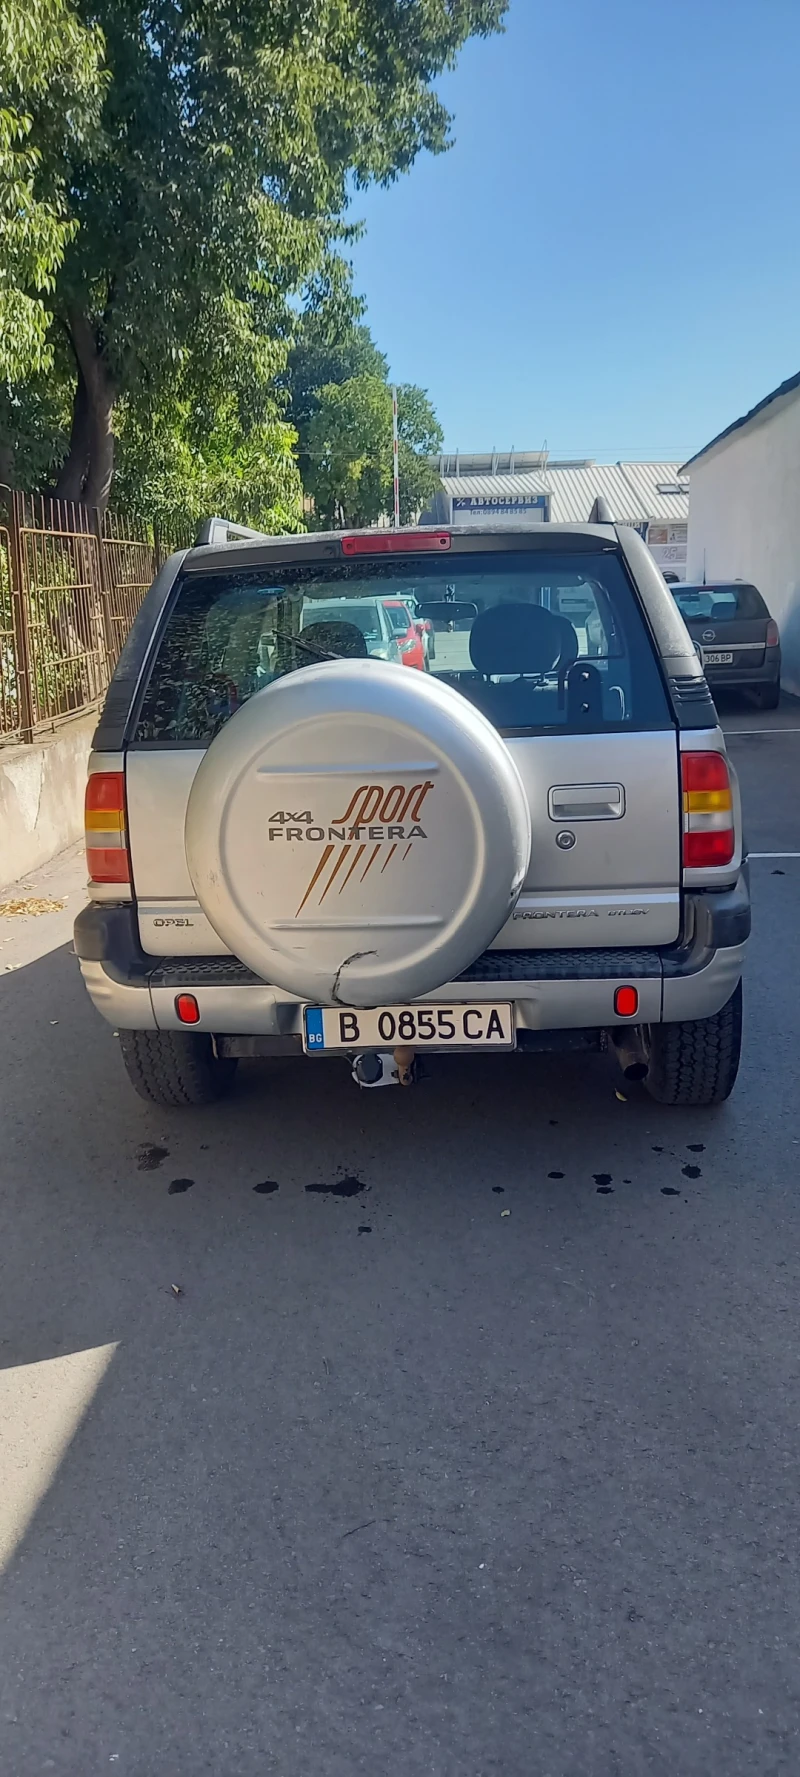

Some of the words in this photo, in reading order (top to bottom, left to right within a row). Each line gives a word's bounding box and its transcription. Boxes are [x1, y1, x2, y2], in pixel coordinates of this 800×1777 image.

[470, 496, 538, 505] АВТОСЕРВИЗ
[268, 826, 428, 841] FRONTERA
[513, 909, 599, 920] FRONTERA
[153, 918, 194, 927] OPEL
[308, 1033, 323, 1043] BG
[339, 1012, 360, 1043] B
[378, 1010, 456, 1041] 0855
[463, 1009, 505, 1040] CA
